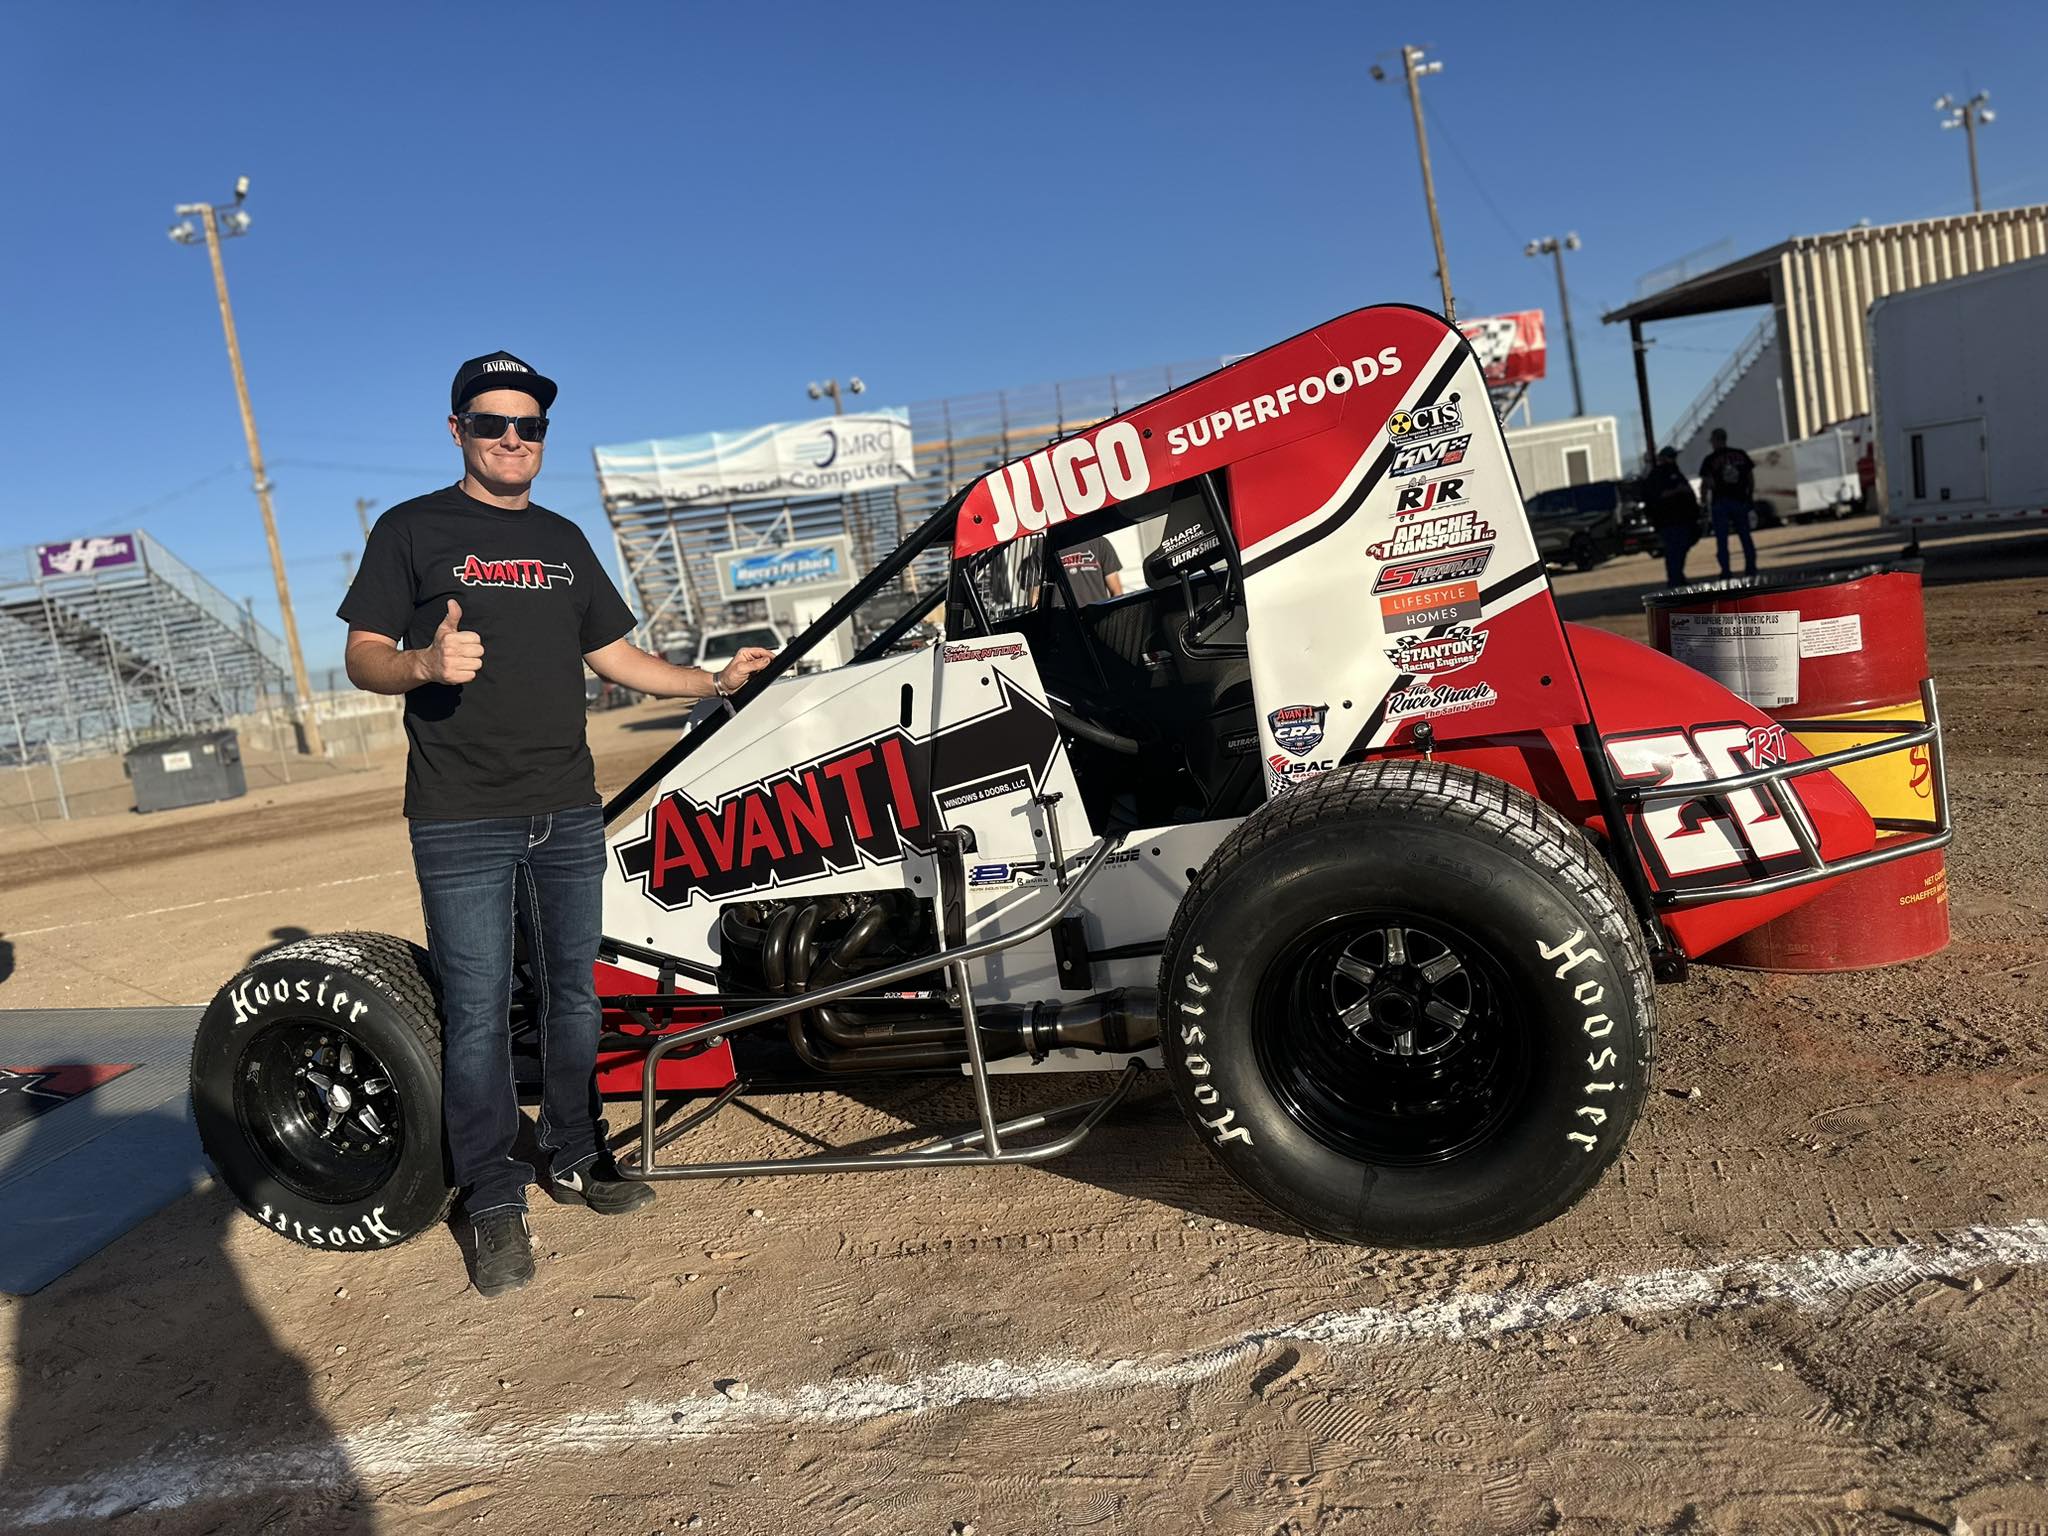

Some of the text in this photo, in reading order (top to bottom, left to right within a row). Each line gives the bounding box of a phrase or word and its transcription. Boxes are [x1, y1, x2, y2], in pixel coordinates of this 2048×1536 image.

[487, 361, 520, 373] AVANTI
[1167, 346, 1402, 456] SUPERFOODS
[1412, 404, 1459, 430] CIS
[986, 421, 1152, 542] JUGO
[1396, 478, 1464, 517] RJR
[1161, 523, 1201, 550] SHARP
[1164, 530, 1205, 553] ADVANTAGE
[1381, 523, 1485, 559] TRANSPORT
[1394, 513, 1474, 545] APACHE
[463, 556, 546, 584] AVANTI
[1380, 556, 1486, 586] SHERMAN
[1412, 567, 1483, 585] RACE CARS
[1393, 587, 1467, 610] LIFESTYLE
[1406, 607, 1458, 626] HOMES
[1765, 614, 1779, 624] PLUS
[943, 643, 1023, 664] THORNTON
[1401, 639, 1474, 664] STANTON
[1402, 654, 1476, 674] Racing Engines
[1388, 682, 1491, 714] Race Shack
[1408, 686, 1431, 697] The
[1277, 707, 1314, 721] AVANTI
[1425, 698, 1496, 719] The Safety Store
[1274, 724, 1322, 739] CRA
[1280, 760, 1334, 775] USAC
[943, 791, 979, 810] WINDOWS
[978, 789, 985, 799] &
[1011, 778, 1027, 791] LLC
[652, 737, 921, 890] AVANTI
[1899, 886, 1937, 906] SCHAEFFER
[228, 974, 369, 1025] Hoosier
[1173, 943, 1254, 1148] Hoosier
[1536, 926, 1625, 1153] Hoosier
[258, 1203, 401, 1245] Hoosier
